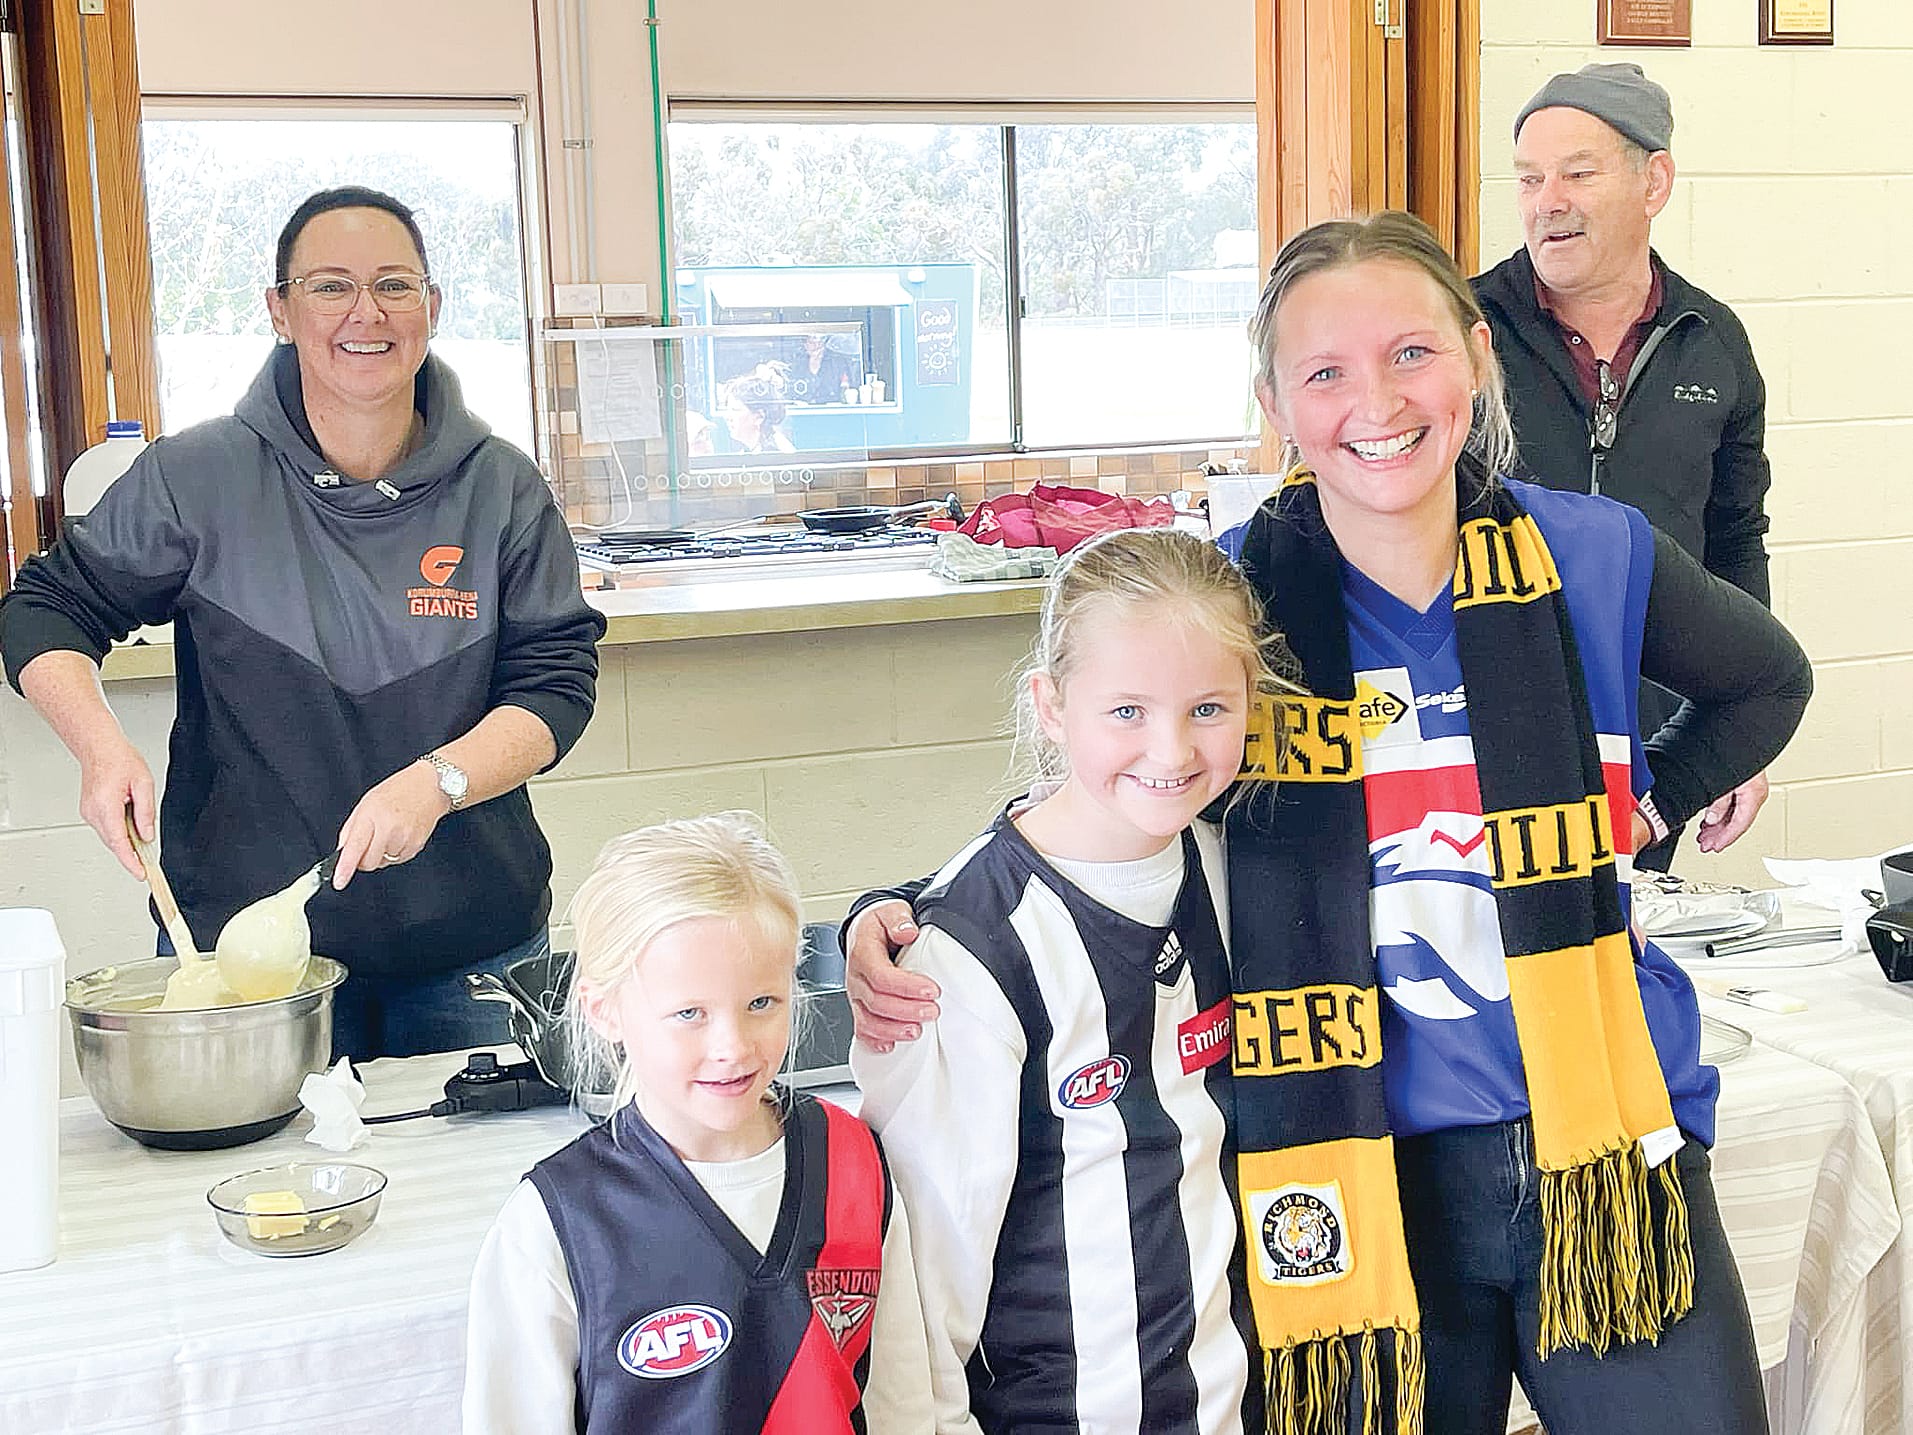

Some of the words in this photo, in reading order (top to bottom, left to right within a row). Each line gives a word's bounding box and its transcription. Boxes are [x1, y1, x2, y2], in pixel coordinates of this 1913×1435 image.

[920, 306, 952, 328] Good
[410, 599, 478, 620] GIANTS
[1233, 991, 1367, 1069] GERS
[1065, 1062, 1124, 1107] AFL
[1263, 1194, 1337, 1233] RICHMOND
[806, 1269, 881, 1298] ESSENDON
[1283, 1261, 1333, 1276] TIGERS
[631, 1316, 724, 1367] AFL
